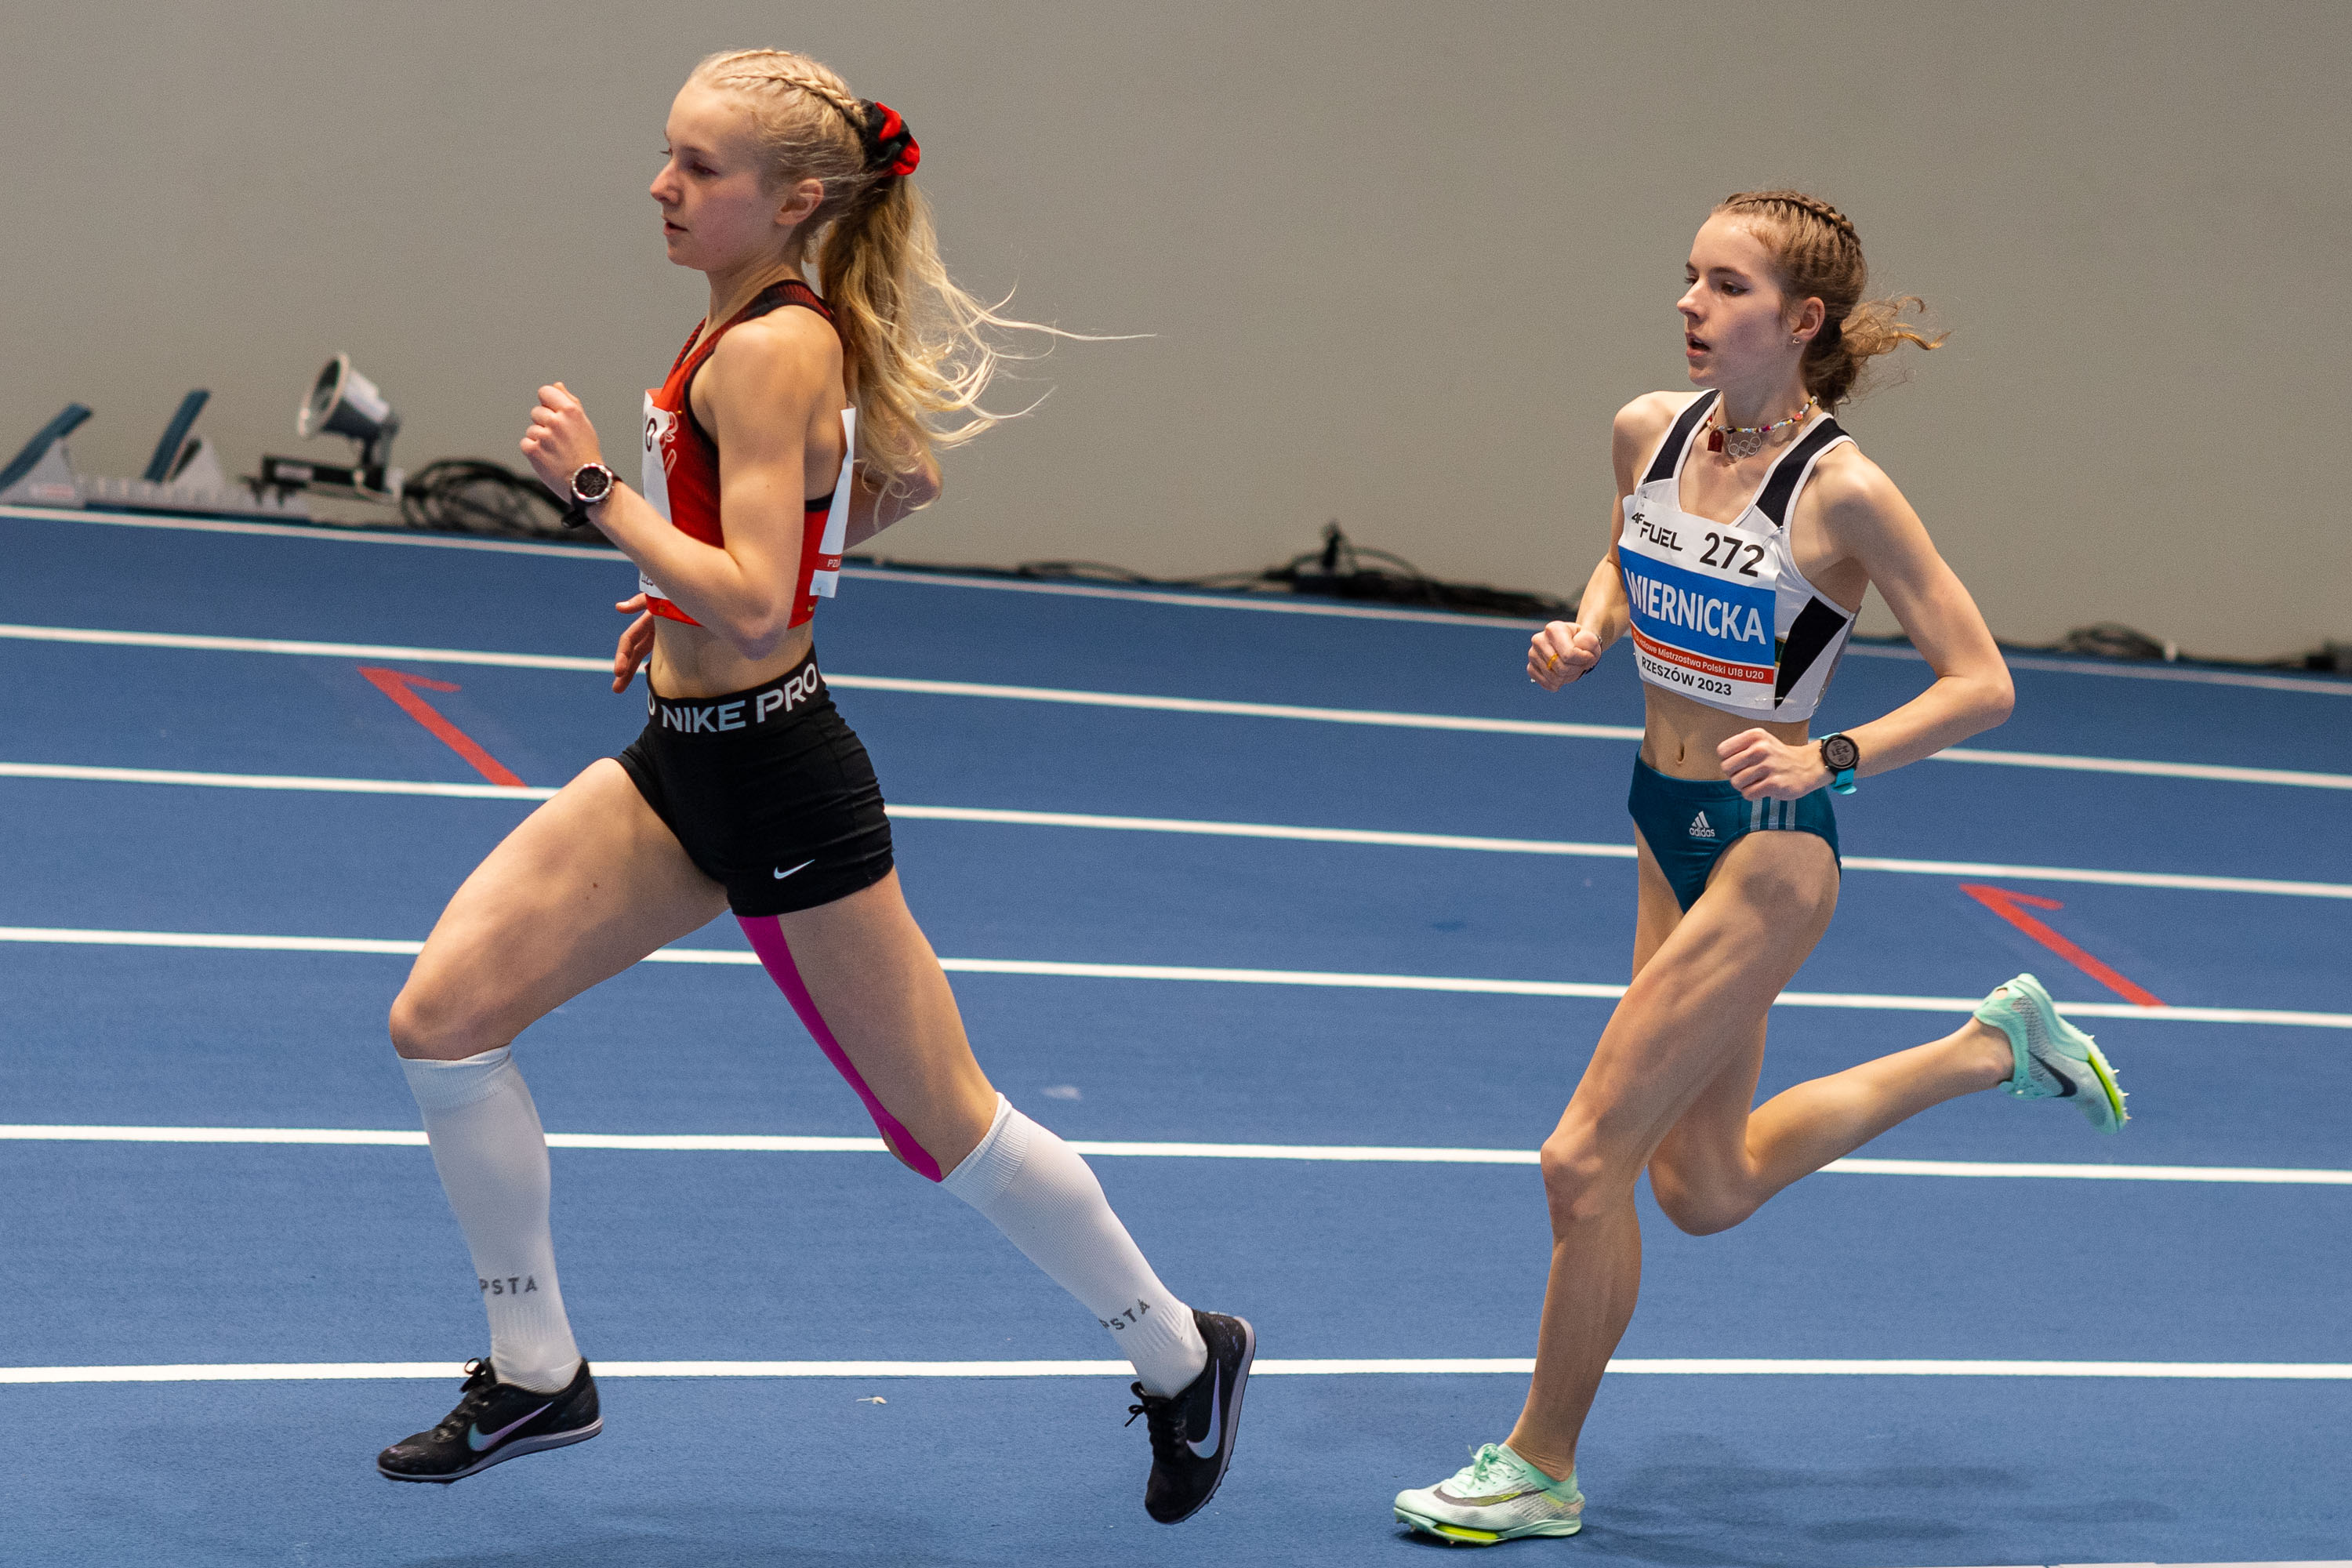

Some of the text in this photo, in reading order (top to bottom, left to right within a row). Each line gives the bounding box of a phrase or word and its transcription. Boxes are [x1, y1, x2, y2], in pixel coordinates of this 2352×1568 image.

[1632, 512, 1646, 524] 4F
[1639, 521, 1683, 552] FUEL
[1699, 532, 1765, 578] 272
[1624, 567, 1767, 645] WIERNICKA
[1641, 655, 1732, 696] RZESZÓW 2023
[1657, 647, 1701, 668] Mistrzostwa
[1702, 661, 1726, 675] Polski
[1727, 666, 1744, 677] U18
[1745, 670, 1765, 680] U20
[661, 699, 746, 734] NIKE
[756, 662, 818, 724] PRO
[1689, 828, 1715, 838] adidas
